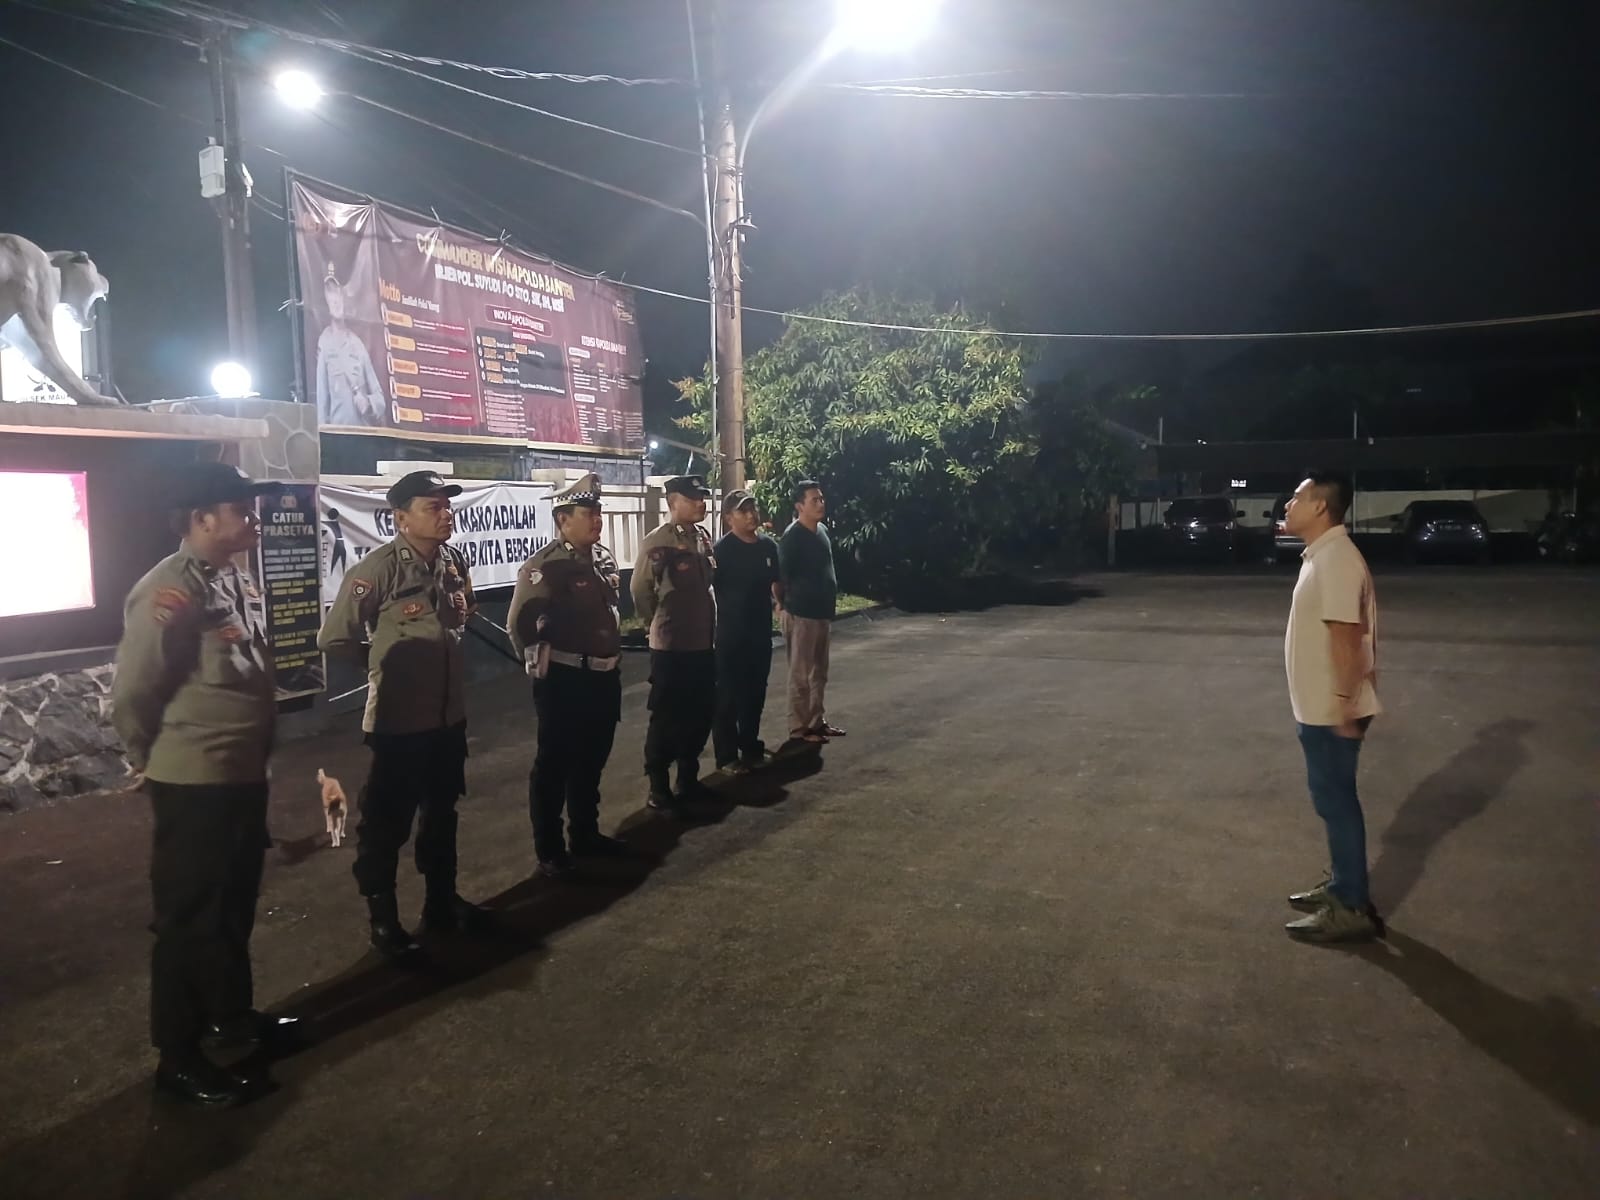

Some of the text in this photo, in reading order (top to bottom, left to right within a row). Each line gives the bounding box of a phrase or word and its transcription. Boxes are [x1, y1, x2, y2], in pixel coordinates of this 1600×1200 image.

[272, 512, 305, 523] CATUR
[459, 505, 493, 533] MAKO
[493, 504, 536, 531] ADALAH
[263, 524, 315, 537] PRASETYA
[479, 540, 504, 567] KITA
